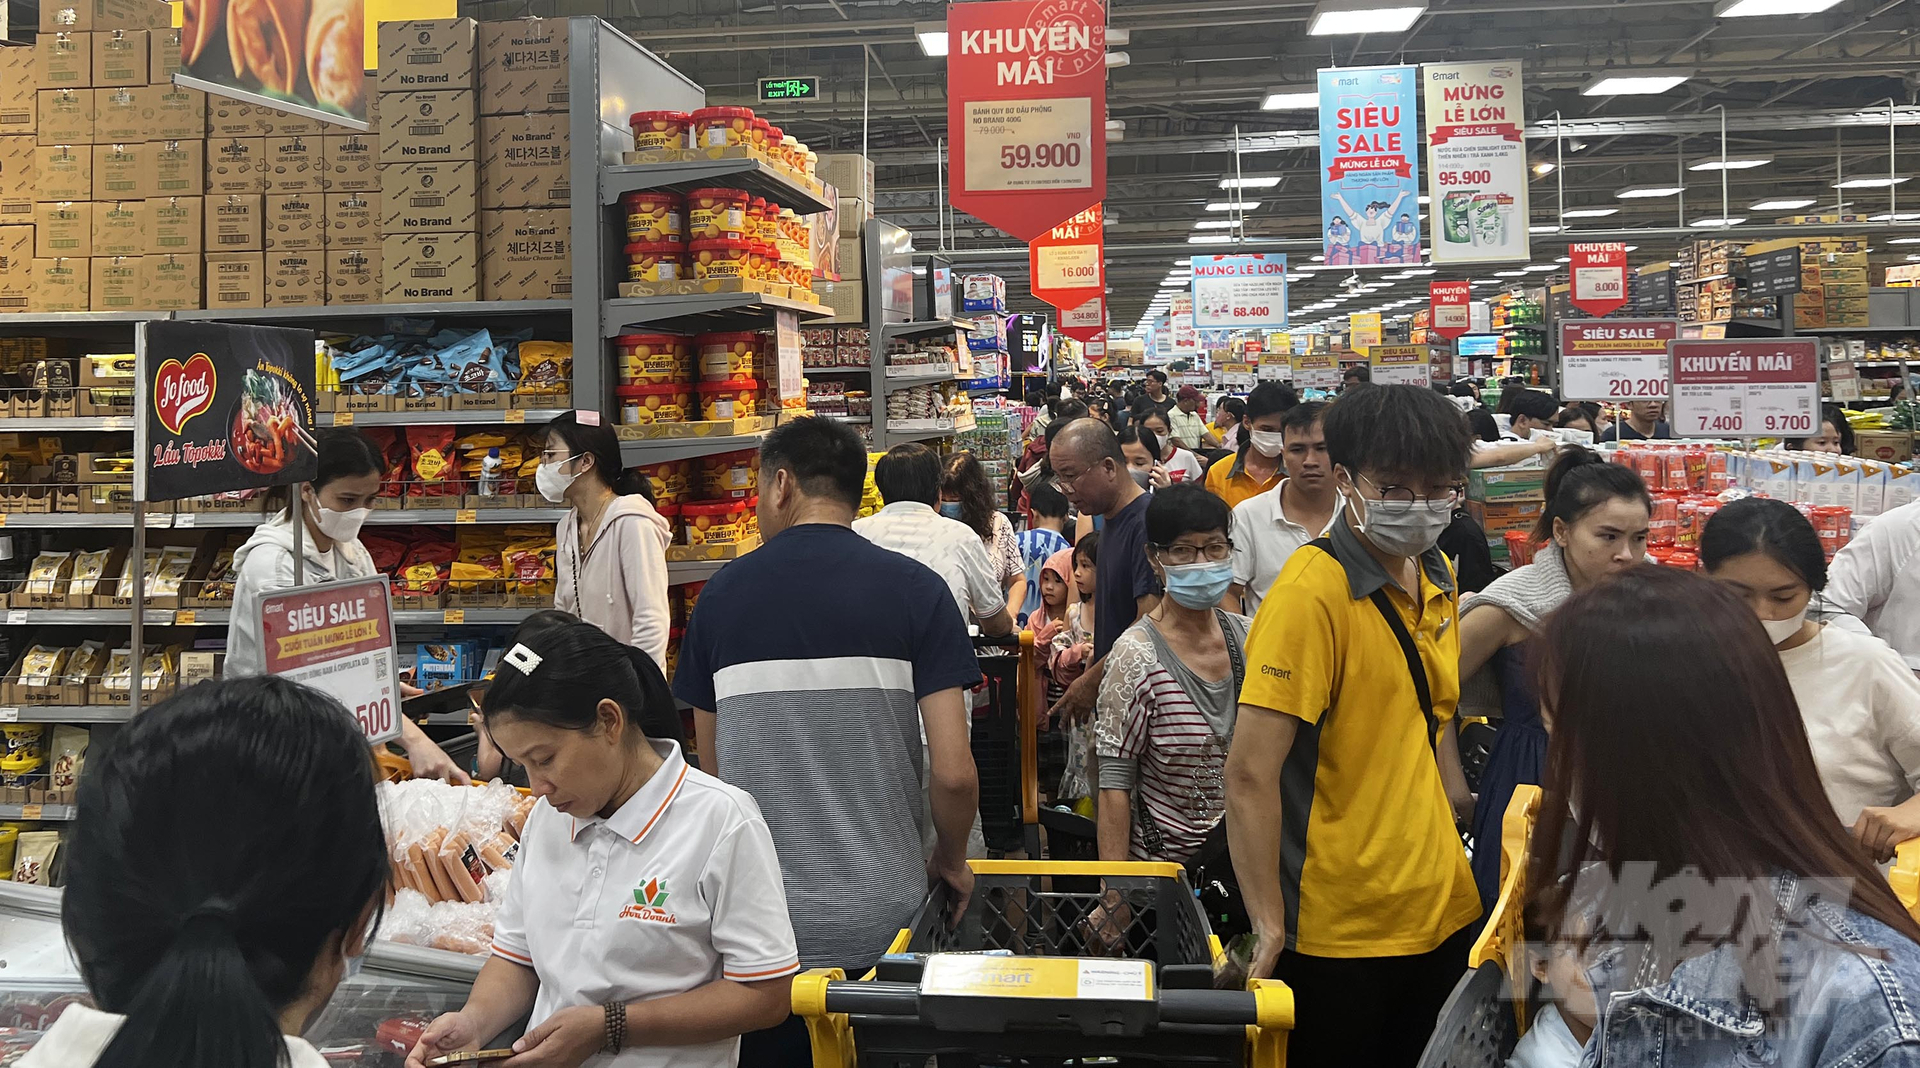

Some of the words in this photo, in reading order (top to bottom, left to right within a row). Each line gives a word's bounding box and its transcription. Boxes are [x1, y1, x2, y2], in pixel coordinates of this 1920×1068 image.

[511, 38, 523, 46] No
[525, 37, 551, 45] Brand
[961, 20, 1090, 55] KHUYẾN
[1073, 26, 1104, 72] price
[997, 55, 1054, 86] MÃI
[1433, 72, 1460, 80] emart
[400, 75, 416, 84] No
[417, 73, 449, 83] Brand
[1444, 84, 1504, 101] MỪNG
[973, 107, 990, 116] BÁNH
[1336, 102, 1400, 129] SIÊU
[1445, 103, 1465, 122] LỄ
[1470, 106, 1506, 121] LỚN
[526, 133, 552, 141] Brand
[1454, 126, 1473, 136] SIÊU
[1475, 127, 1497, 135] SALE
[402, 146, 417, 155] No
[418, 145, 451, 154] Brand
[1337, 133, 1402, 154] SALE
[505, 145, 561, 160] 체다치즈볼
[1001, 143, 1081, 169] 59.900
[1339, 160, 1368, 169] MỪNG
[1370, 158, 1380, 168] LỄ
[1381, 158, 1400, 168] LỚN
[1439, 170, 1491, 185] 95.900
[403, 218, 418, 227] No
[420, 217, 452, 226] Brand
[1052, 225, 1080, 239] MÃI
[507, 241, 565, 255] 체다치즈볼
[1588, 252, 1608, 263] MÃI
[1061, 266, 1095, 277] 16.000
[404, 289, 419, 297] No
[421, 287, 453, 297] Brand
[1433, 286, 1467, 294] KHUYẾN
[1595, 283, 1619, 292] 8.000
[1442, 294, 1458, 303] MÃI
[1072, 312, 1098, 320] 334.800
[1233, 307, 1269, 317] 68.400
[1583, 326, 1614, 339] SIÊU
[1619, 328, 1655, 338] SALE
[1680, 351, 1751, 372] KHUYẾN
[1757, 354, 1792, 371] MÃI
[464, 369, 484, 382] 초코바
[161, 375, 177, 408] Jo
[175, 372, 209, 406] food
[1698, 416, 1742, 431] 7.400
[1765, 415, 1810, 430] 9.700
[153, 440, 181, 468] Lẩu
[183, 439, 226, 468] Topokki
[421, 458, 441, 467] 초코바
[198, 500, 211, 508] No
[265, 603, 284, 614] emart
[288, 603, 325, 632] SIÊU
[330, 599, 366, 624] SALE
[284, 639, 301, 652] CUỐI
[304, 635, 323, 647] TUẦN
[325, 632, 344, 643] MỪNG
[354, 626, 367, 637] LỚN
[1261, 665, 1292, 680] emart
